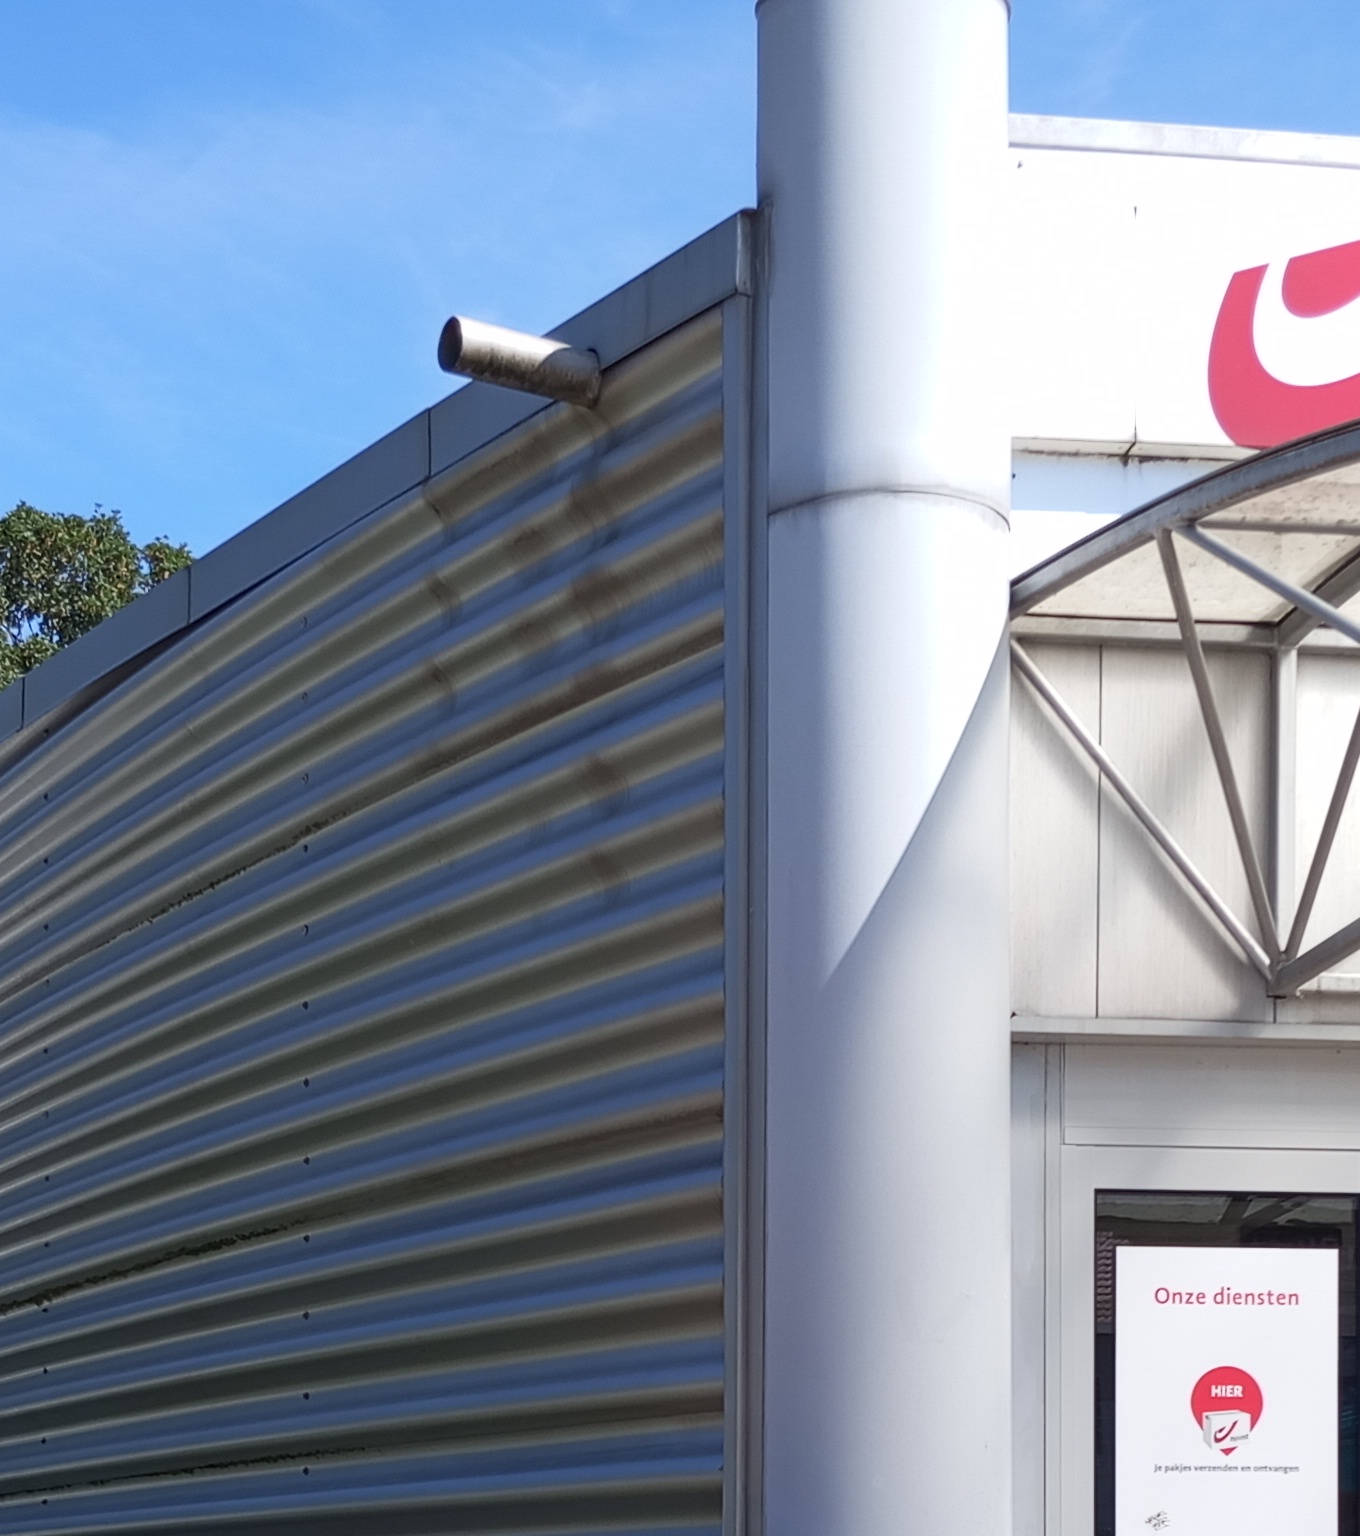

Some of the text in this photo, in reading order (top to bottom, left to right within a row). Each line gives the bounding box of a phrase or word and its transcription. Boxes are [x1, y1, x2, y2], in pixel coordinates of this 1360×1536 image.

[1154, 1286, 1299, 1306] Onze diensten
[1210, 1384, 1244, 1398] HIER
[1154, 1464, 1162, 1473] Je
[1164, 1464, 1191, 1473] pakjes
[1194, 1464, 1239, 1472] verzenden
[1253, 1465, 1300, 1474] ontvangen
